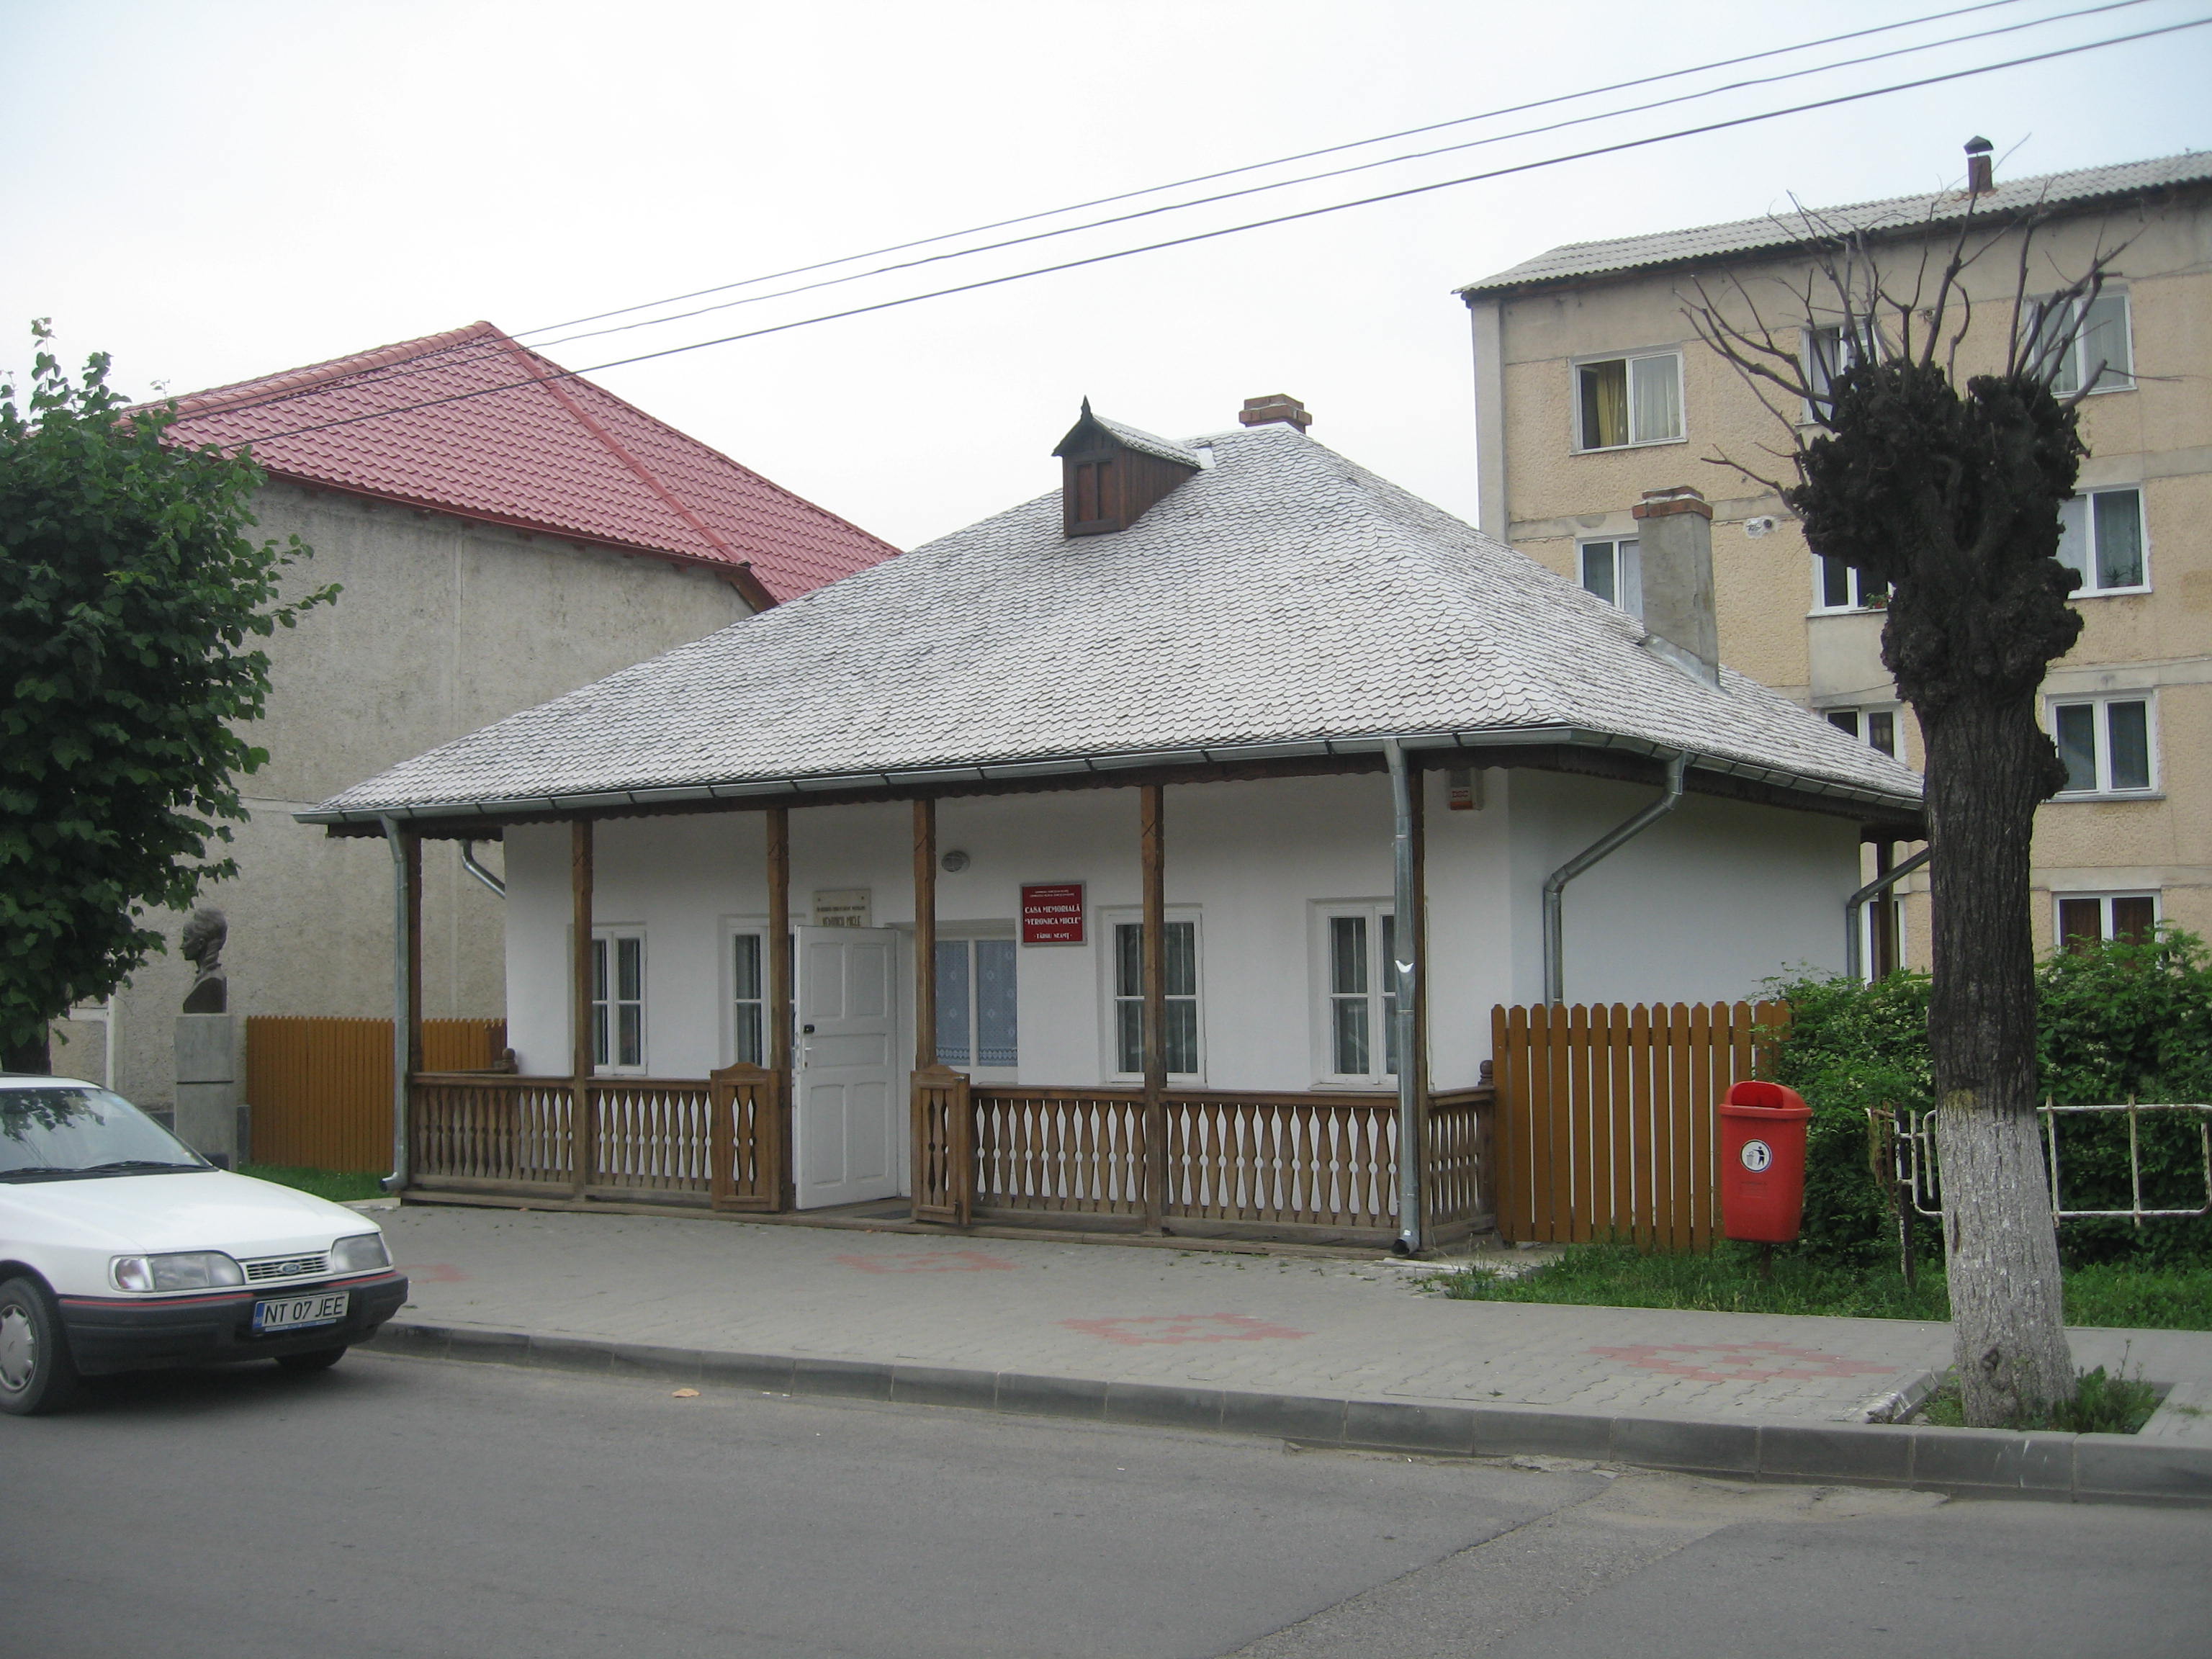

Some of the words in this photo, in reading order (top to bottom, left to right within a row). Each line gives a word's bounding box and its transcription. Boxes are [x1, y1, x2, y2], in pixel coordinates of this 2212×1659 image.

[264, 1303, 287, 1323] NT
[293, 1300, 313, 1321] 07
[315, 1295, 346, 1318] JEE
